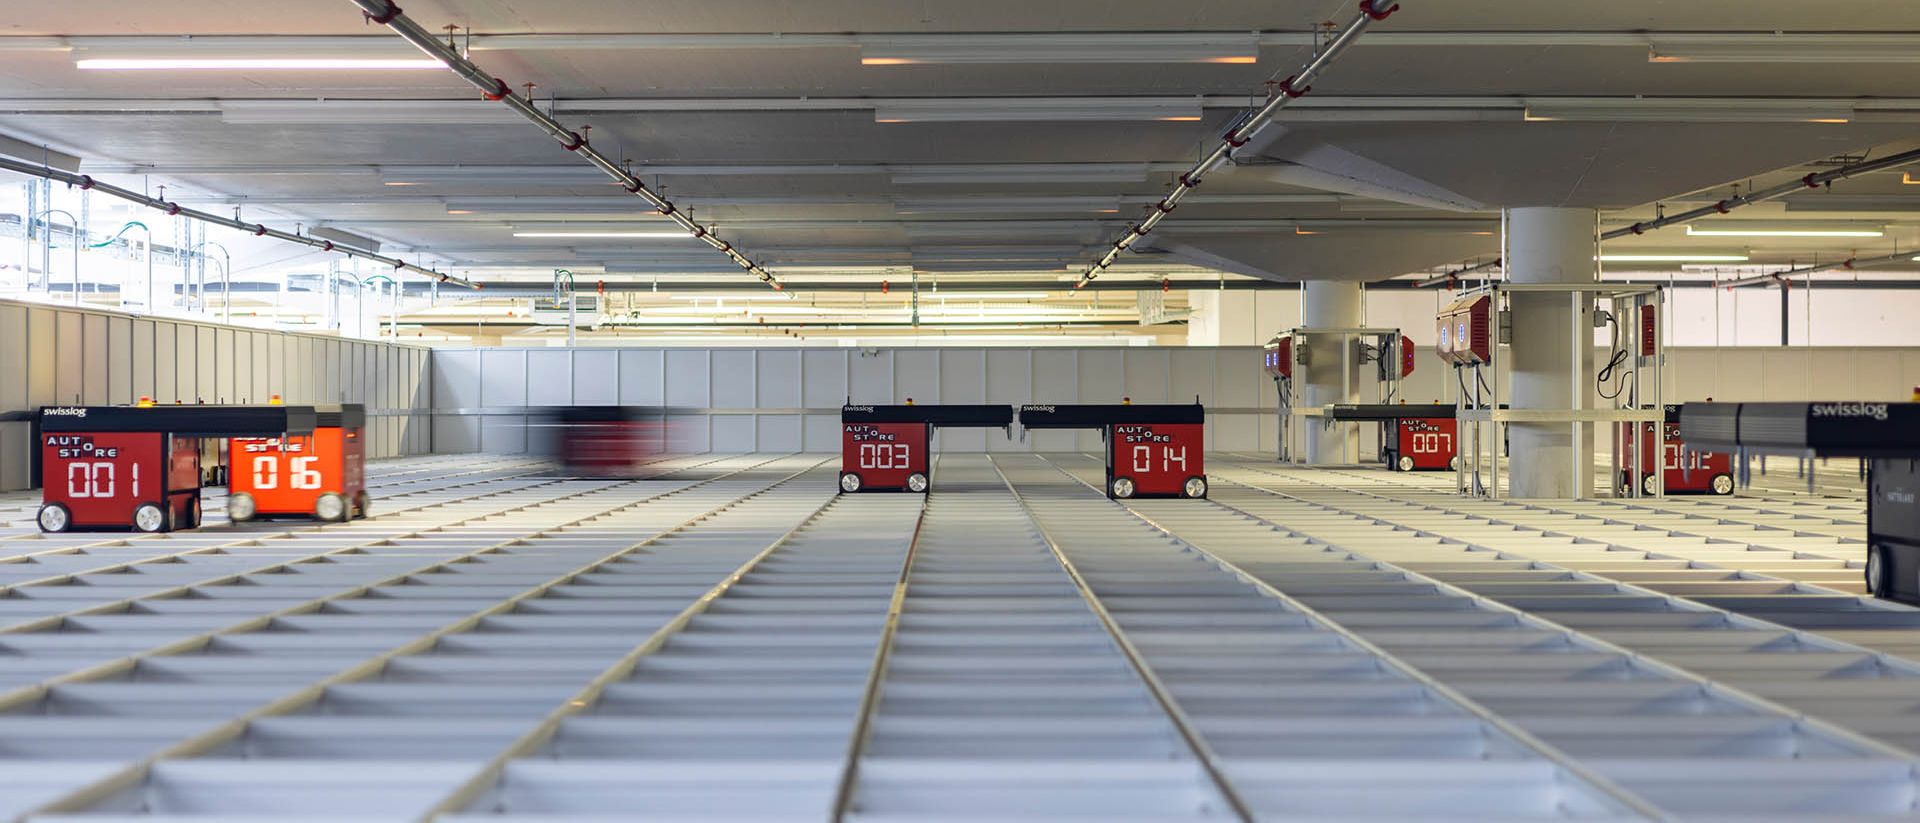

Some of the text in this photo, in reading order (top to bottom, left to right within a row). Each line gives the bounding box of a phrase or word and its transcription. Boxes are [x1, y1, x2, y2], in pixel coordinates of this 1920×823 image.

[44, 407, 87, 417] swisslog
[1023, 404, 1056, 413] swisslog
[1812, 402, 1889, 420] swisslog
[1413, 433, 1452, 453] 007
[860, 443, 910, 469] 003
[1133, 445, 1187, 473] 014
[68, 462, 139, 498] 001
